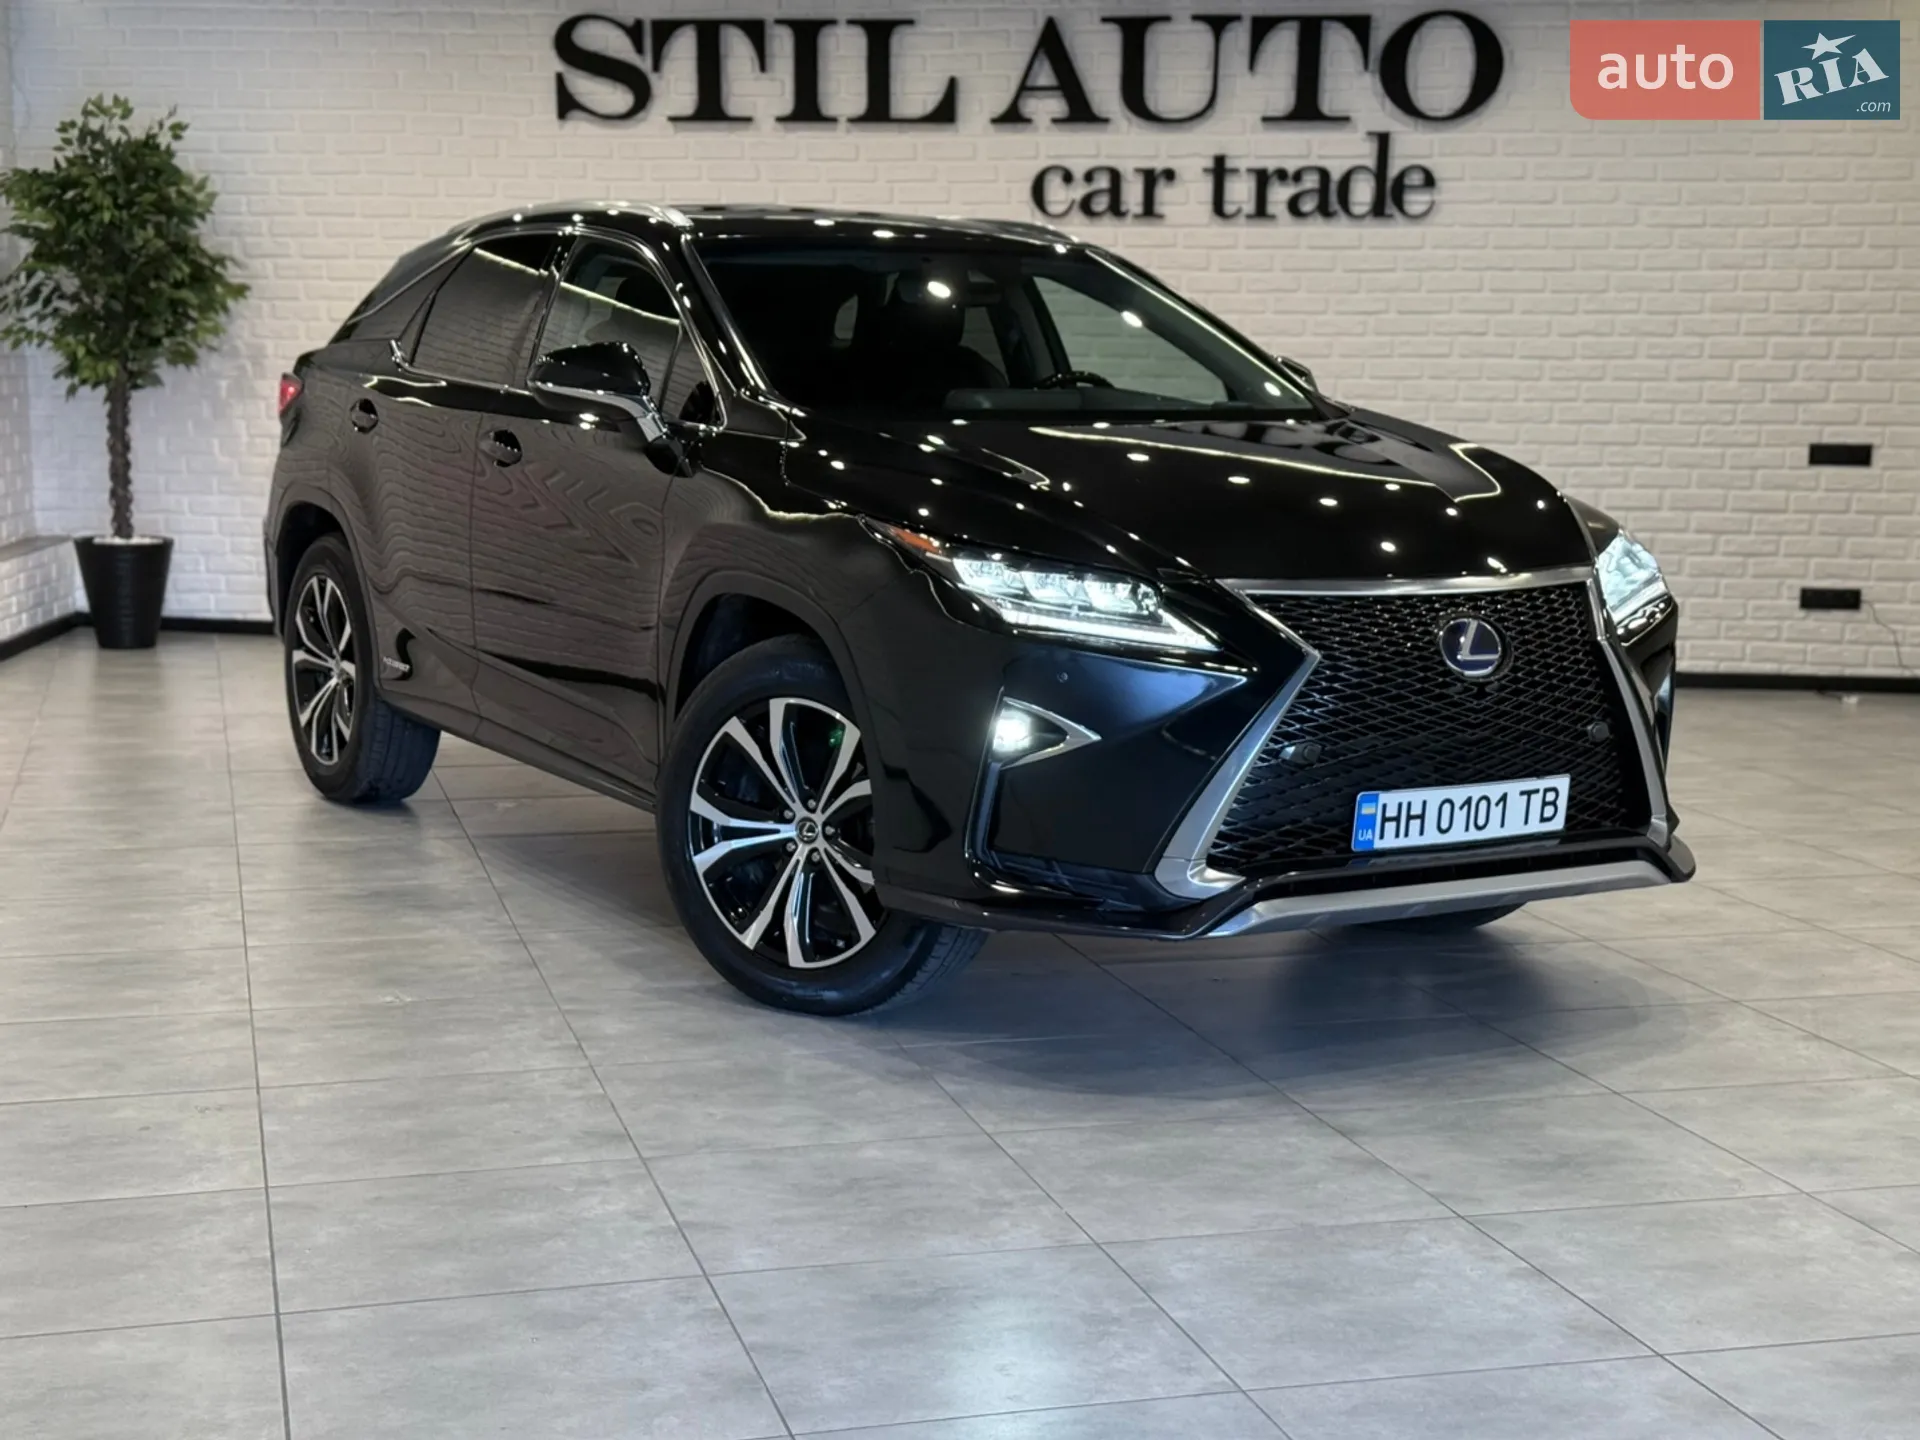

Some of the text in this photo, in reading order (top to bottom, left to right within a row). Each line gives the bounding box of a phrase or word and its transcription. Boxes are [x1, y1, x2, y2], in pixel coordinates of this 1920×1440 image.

[554, 10, 1504, 122] STIL AUTO
[1031, 132, 1435, 219] car trade
[1358, 828, 1373, 841] UA
[1379, 787, 1560, 840] HH 0101 TB
